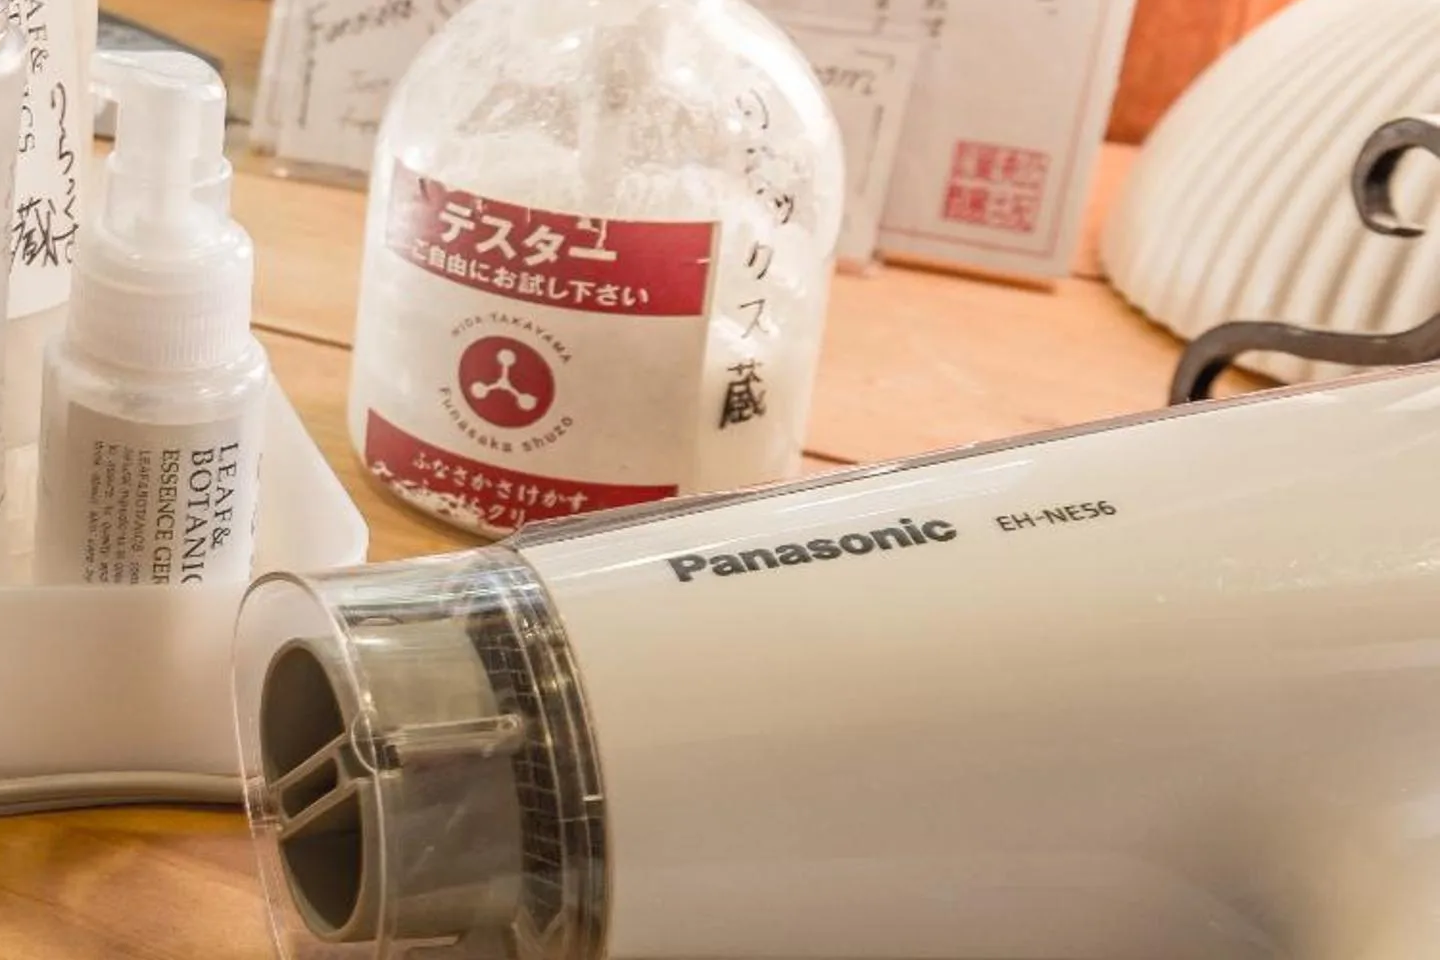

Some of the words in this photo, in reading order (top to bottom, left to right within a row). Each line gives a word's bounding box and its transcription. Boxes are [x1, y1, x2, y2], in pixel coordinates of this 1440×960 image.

[409, 238, 651, 308] ご自由にお試し下さい
[155, 449, 180, 540] ESSENCE
[180, 448, 214, 584] BOTANIC
[211, 442, 239, 550] LEAF&
[668, 517, 957, 582] Panasonic
[995, 499, 1117, 532] EH-NE56
